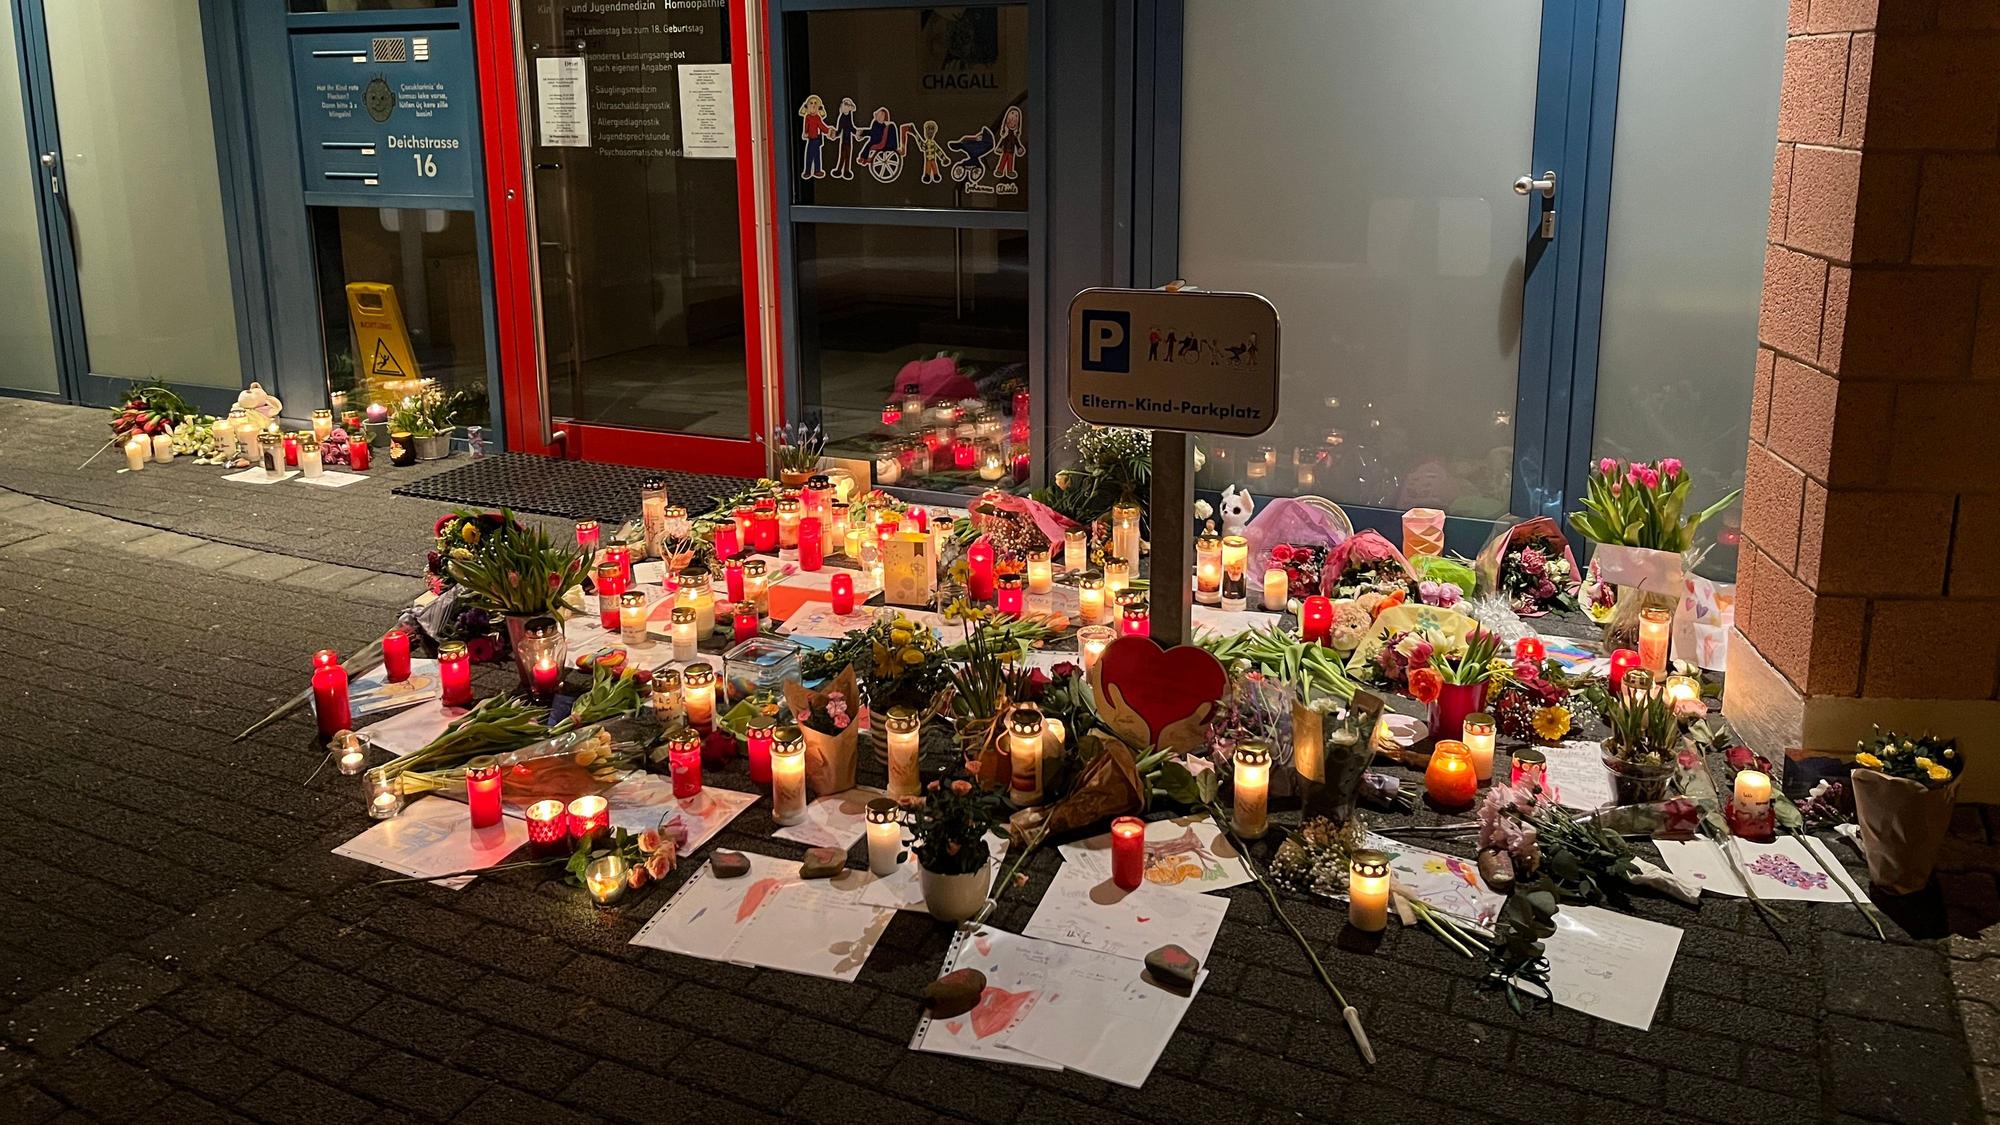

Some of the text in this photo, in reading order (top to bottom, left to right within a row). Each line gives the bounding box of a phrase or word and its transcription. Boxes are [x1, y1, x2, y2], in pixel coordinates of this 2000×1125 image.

[572, 2, 588, 12] und
[590, 1, 656, 14] Jugendmedizin
[584, 27, 620, 37] Lebenstag
[622, 26, 632, 34] bis
[651, 24, 661, 33] 18.
[663, 24, 704, 34] Geburtstag
[622, 50, 686, 61] Leistungsangebot
[612, 64, 639, 74] eigenen
[641, 63, 672, 73] Angaben
[922, 73, 999, 89] CHAGALL
[596, 102, 670, 112] Ultraschalldiagnostik
[598, 117, 659, 128] Allergiediagnostik
[388, 134, 459, 149] Deichstrasse
[598, 132, 670, 142] Jugendsprechstunde
[600, 147, 664, 158] Psychosomatische
[414, 154, 437, 177] 16
[1089, 320, 1124, 362] P
[1082, 394, 1260, 420] Eltern-Kind-Parkplatz
